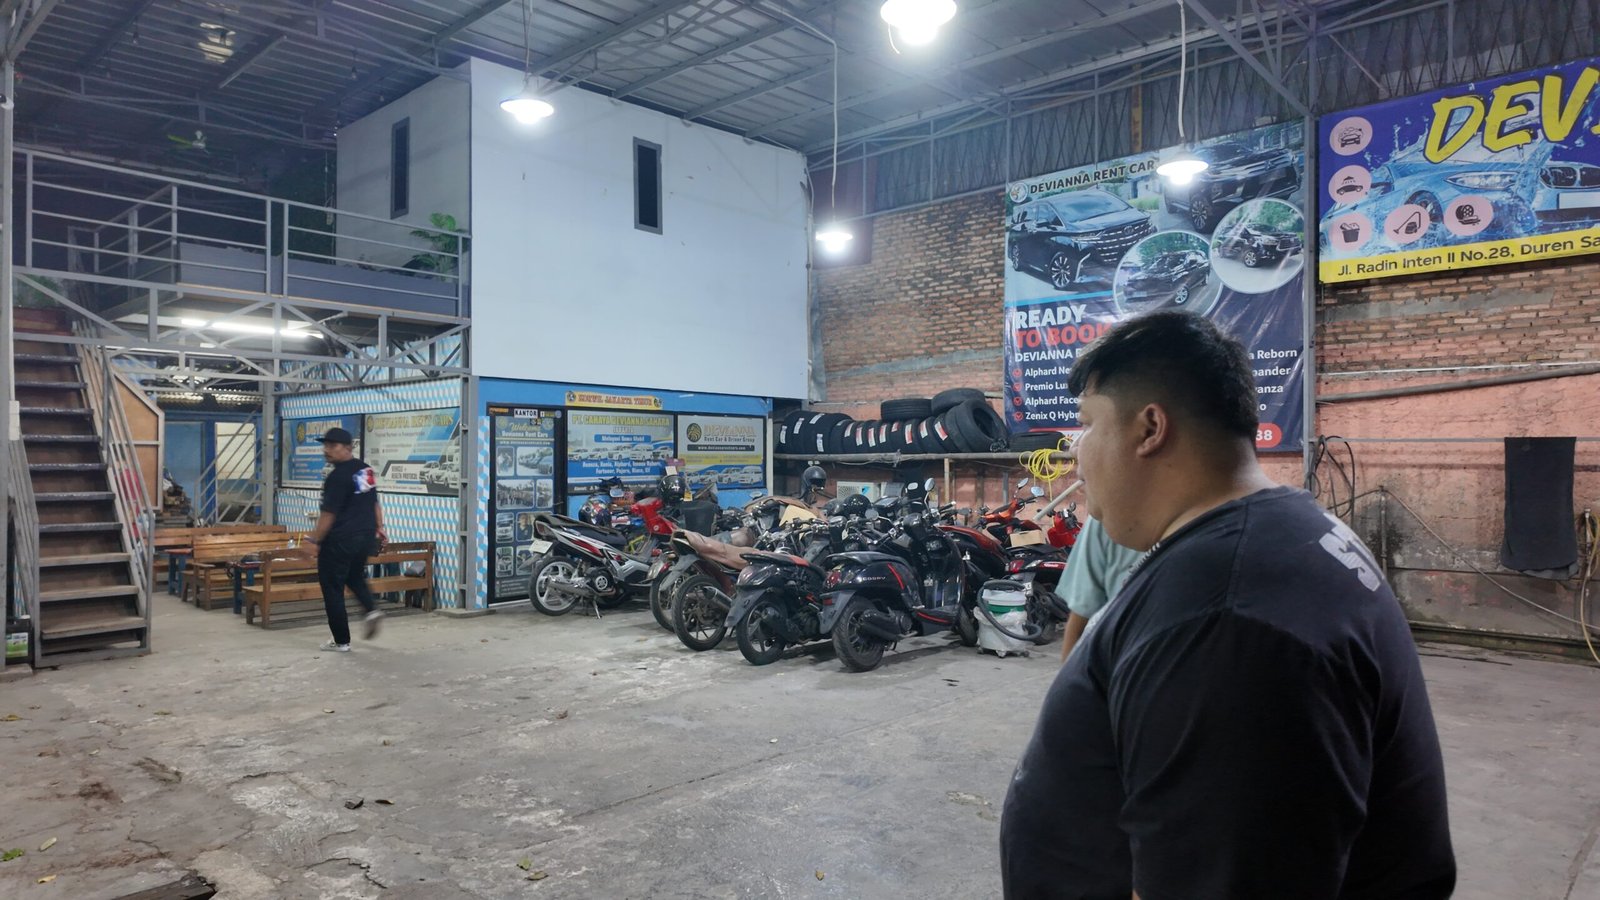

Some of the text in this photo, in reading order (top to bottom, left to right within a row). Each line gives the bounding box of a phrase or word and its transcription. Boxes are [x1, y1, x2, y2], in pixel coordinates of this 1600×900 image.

[1423, 67, 1600, 164] DEV
[1030, 160, 1155, 194] DEVIANNA RENT CAR
[1338, 262, 1351, 276] Jl.
[1357, 261, 1398, 275] Radin
[1403, 255, 1442, 269] Inten
[1521, 238, 1574, 255] Duren
[1015, 304, 1087, 329] READY
[1015, 322, 1112, 349] TO BOOK
[1014, 349, 1073, 362] DEVIANNA
[1257, 349, 1297, 359] Reborn
[1025, 366, 1057, 378] Alphard
[1252, 366, 1291, 376] pander
[1025, 382, 1054, 391] Premio
[1256, 385, 1283, 393] anza
[1025, 396, 1057, 407] Alphard
[610, 415, 643, 426] DEVIANNA
[1025, 411, 1048, 420] Zenix
[1049, 411, 1056, 421] Q
